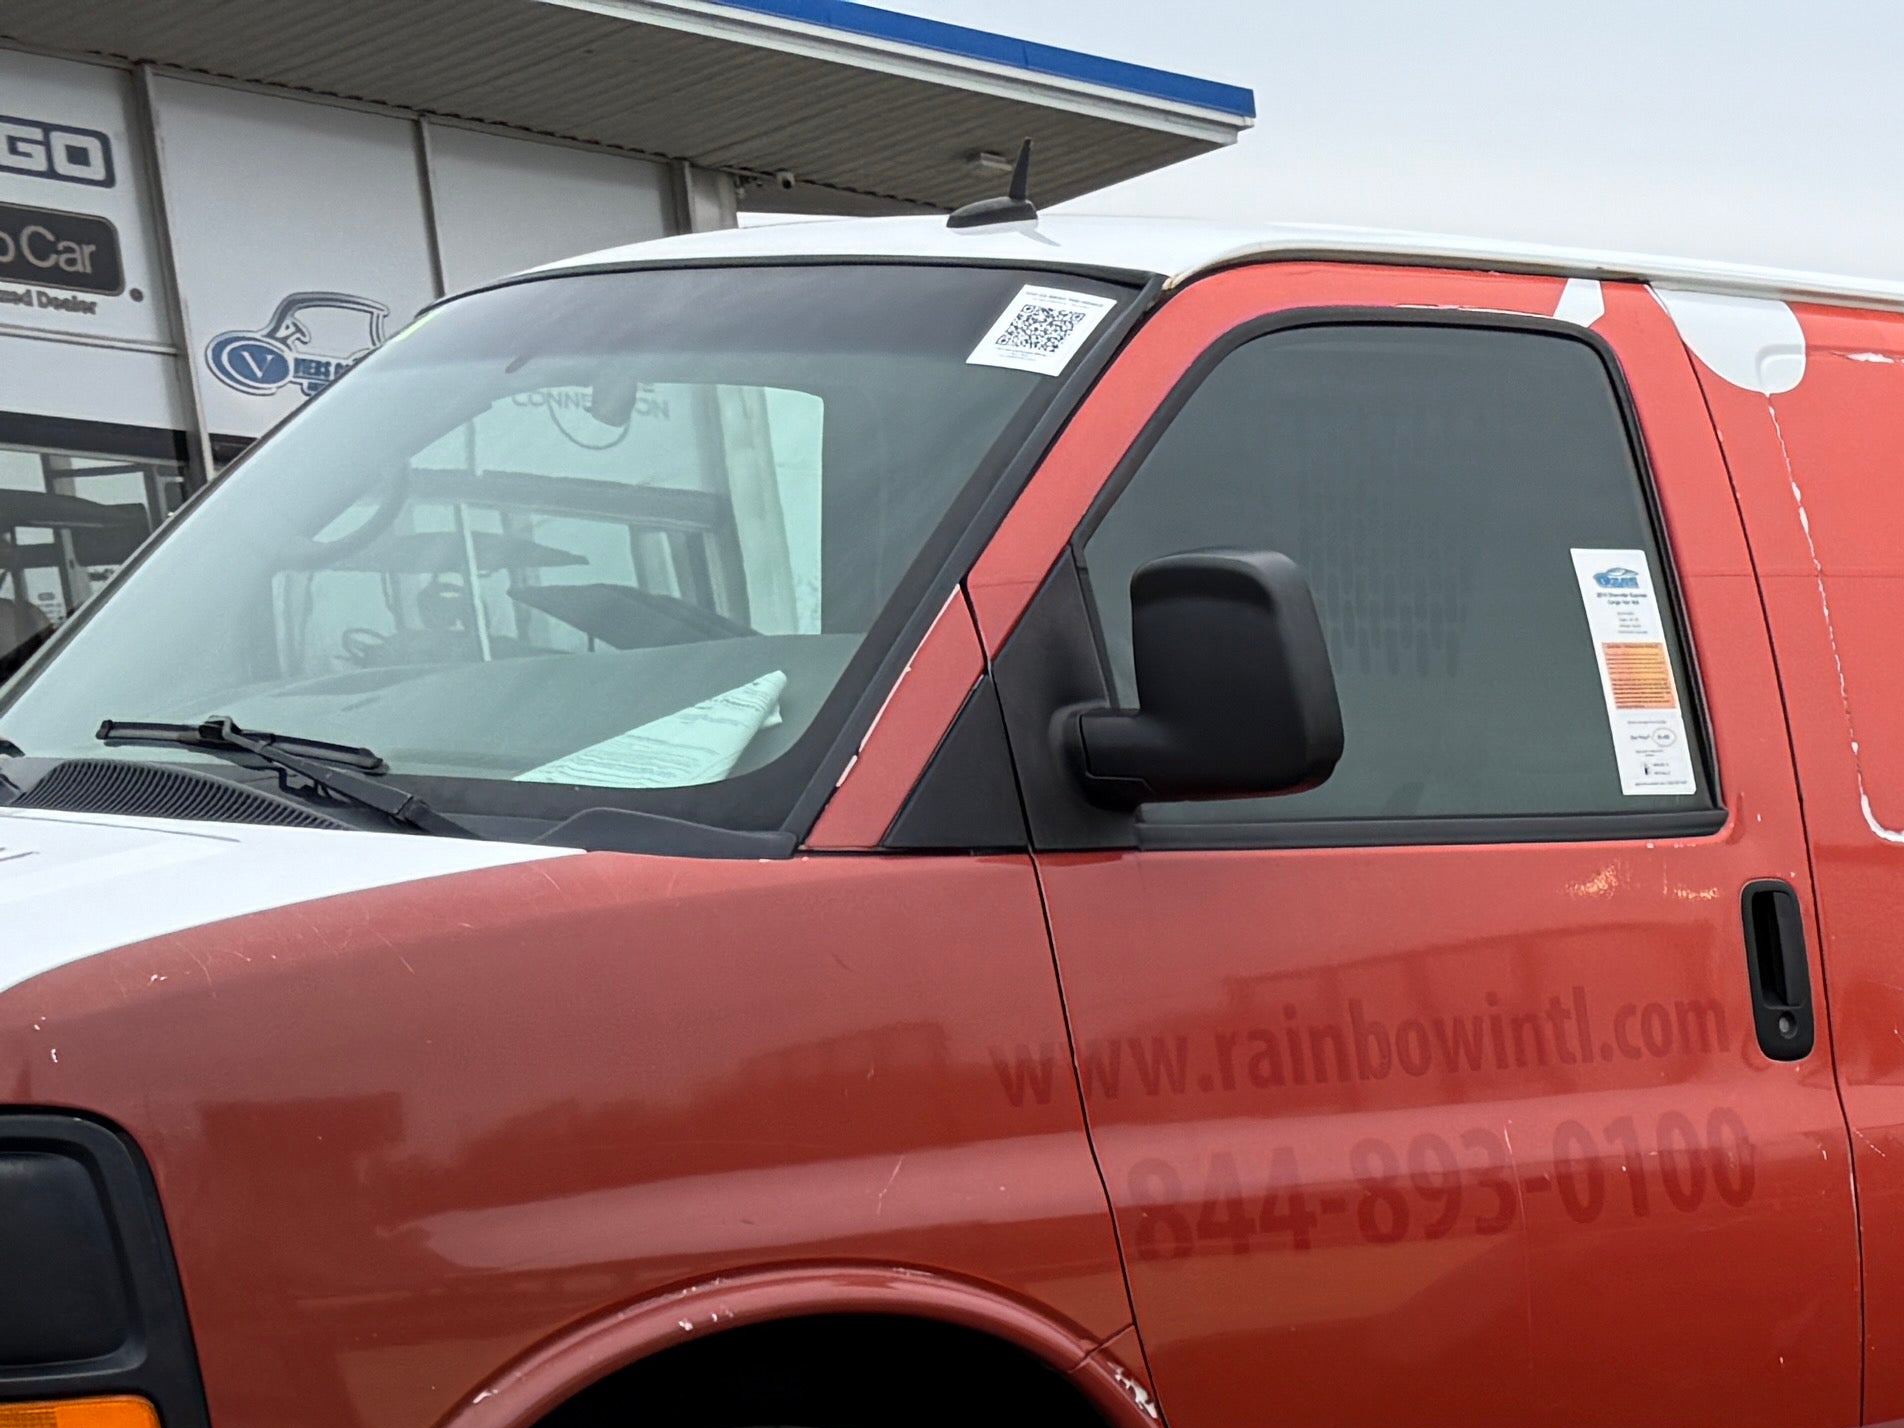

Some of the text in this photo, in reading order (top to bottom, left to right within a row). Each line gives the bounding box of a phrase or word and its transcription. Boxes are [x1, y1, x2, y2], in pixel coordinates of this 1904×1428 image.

[19, 225, 96, 274] Car
[993, 987, 1731, 1107] www.rainbowintl.com
[1126, 1105, 1757, 1264] 844-893-0100
